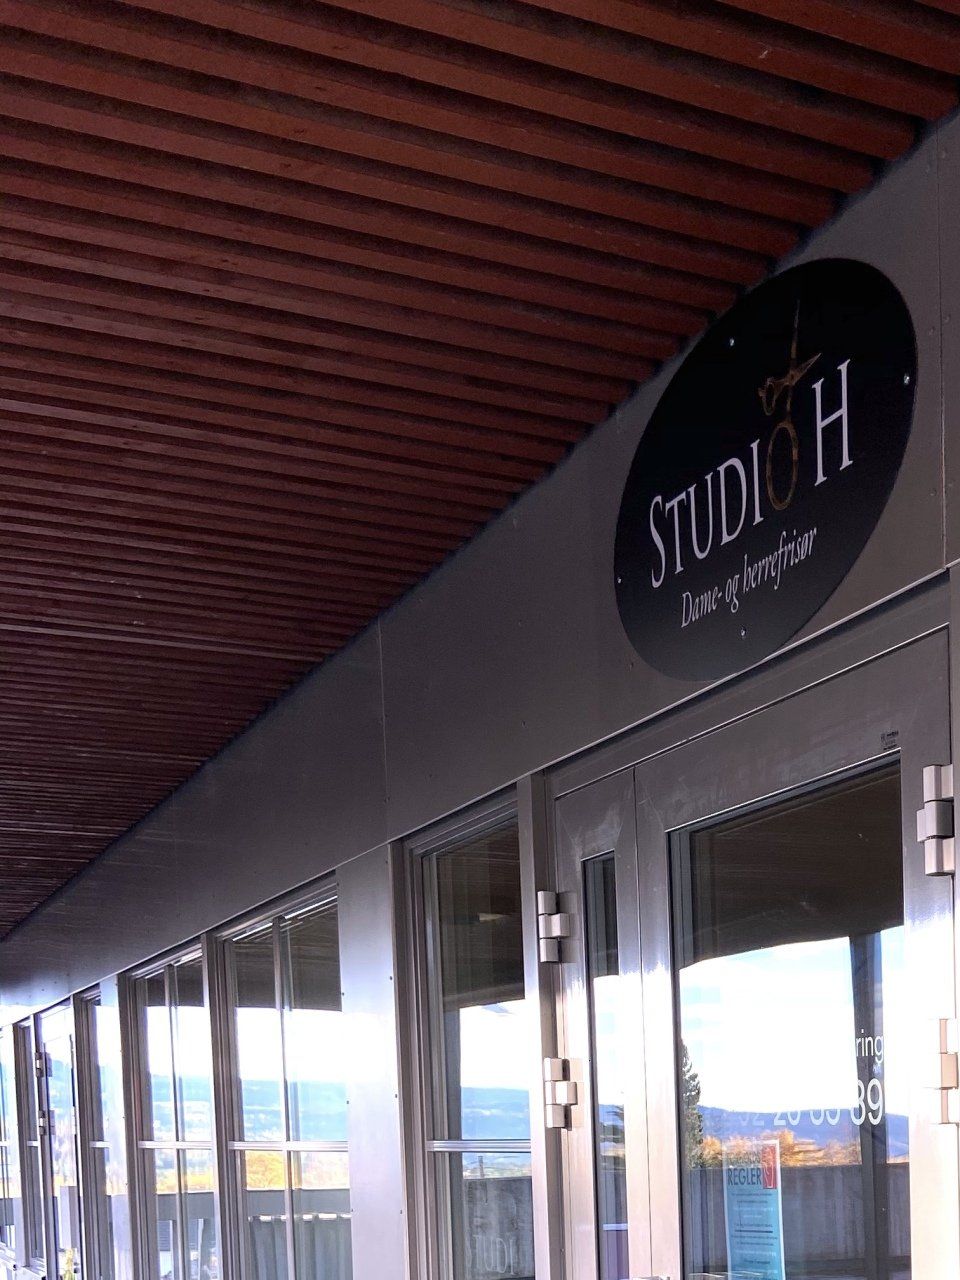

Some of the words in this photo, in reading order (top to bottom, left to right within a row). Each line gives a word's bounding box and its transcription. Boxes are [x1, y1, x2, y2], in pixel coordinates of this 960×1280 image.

[811, 358, 854, 487] H
[681, 591, 722, 628] Dame-
[725, 574, 740, 613] og
[743, 527, 817, 591] herrefrisør
[728, 1167, 762, 1186] REGLER
